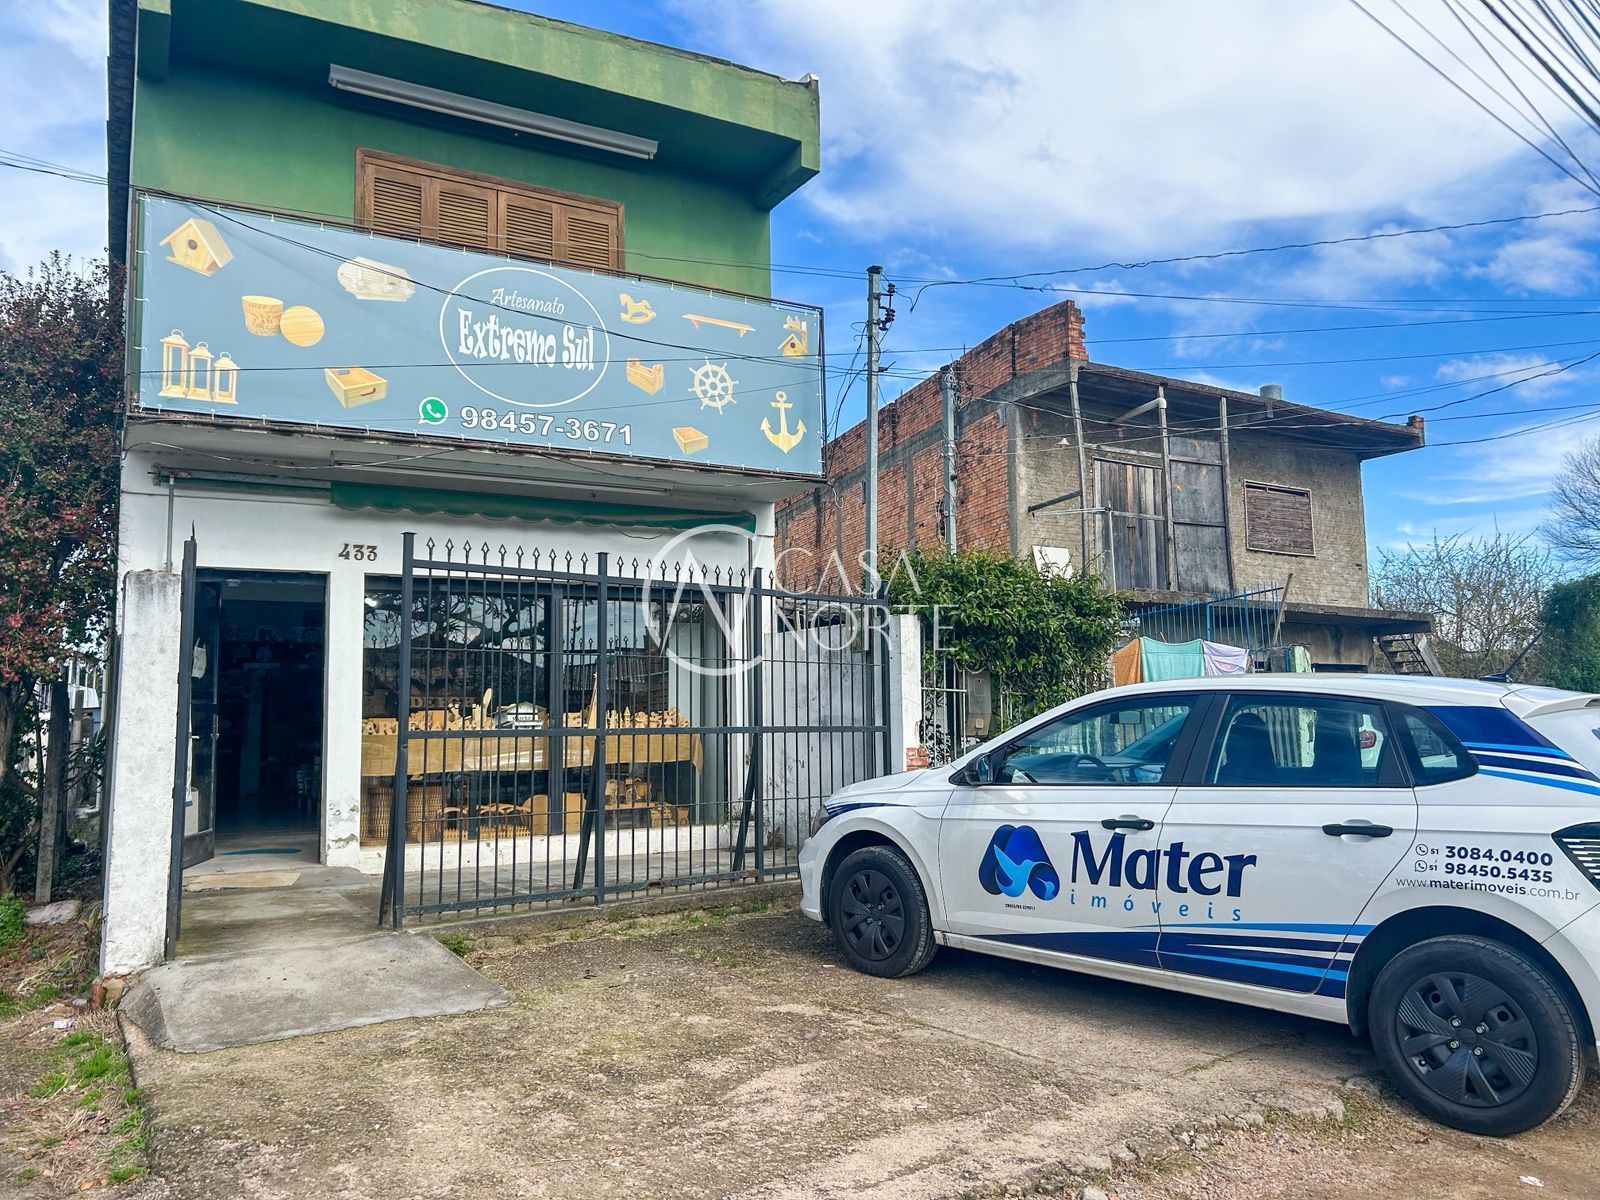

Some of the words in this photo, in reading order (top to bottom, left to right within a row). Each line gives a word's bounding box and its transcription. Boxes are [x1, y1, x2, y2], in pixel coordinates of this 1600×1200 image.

[491, 288, 565, 316] Artesanato
[457, 307, 556, 369] Extremo
[562, 325, 595, 372] Sul
[460, 406, 632, 446] 98457-3671
[338, 543, 378, 562] 433
[1071, 830, 1258, 898] Mater
[1445, 845, 1553, 867] 3084.0400
[1444, 862, 1553, 884] 98450.5435
[1395, 877, 1580, 901] www.materimoveis.com.br
[1071, 889, 1241, 922] imóveis
